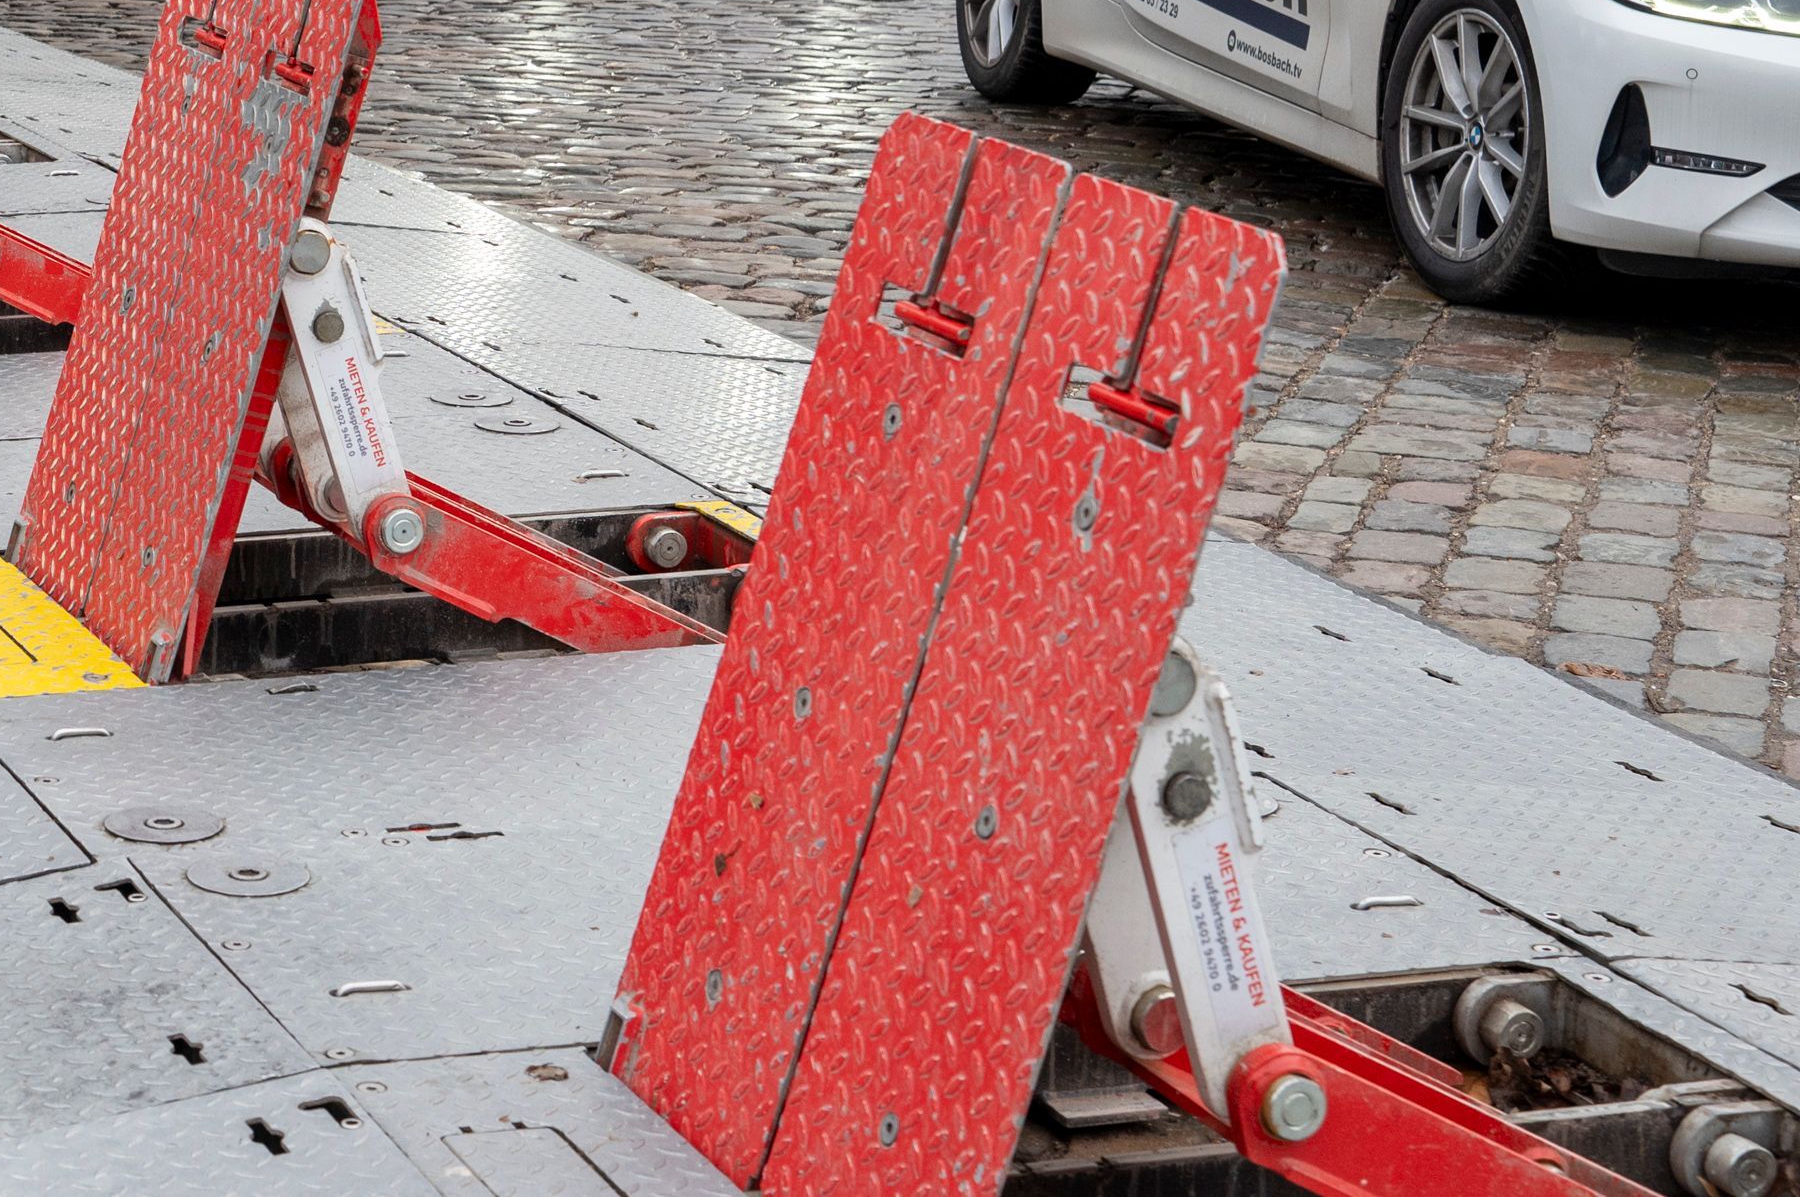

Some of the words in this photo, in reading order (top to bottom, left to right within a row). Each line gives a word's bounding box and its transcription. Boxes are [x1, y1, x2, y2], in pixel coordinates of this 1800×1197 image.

[1169, 2, 1179, 19] 29
[1236, 39, 1303, 79] www.bosbach.tv
[345, 357, 367, 404] MIETEN
[330, 387, 338, 402] +49
[334, 404, 345, 425] 2602
[339, 378, 368, 456] zufahrtssperre.de
[360, 407, 370, 417] &
[364, 418, 386, 467] KAUFEN
[1214, 842, 1243, 913] MIETEN
[1204, 873, 1240, 991] zufahrtssperre.de
[1232, 917, 1246, 931] &
[1237, 934, 1266, 1007] KAUFEN
